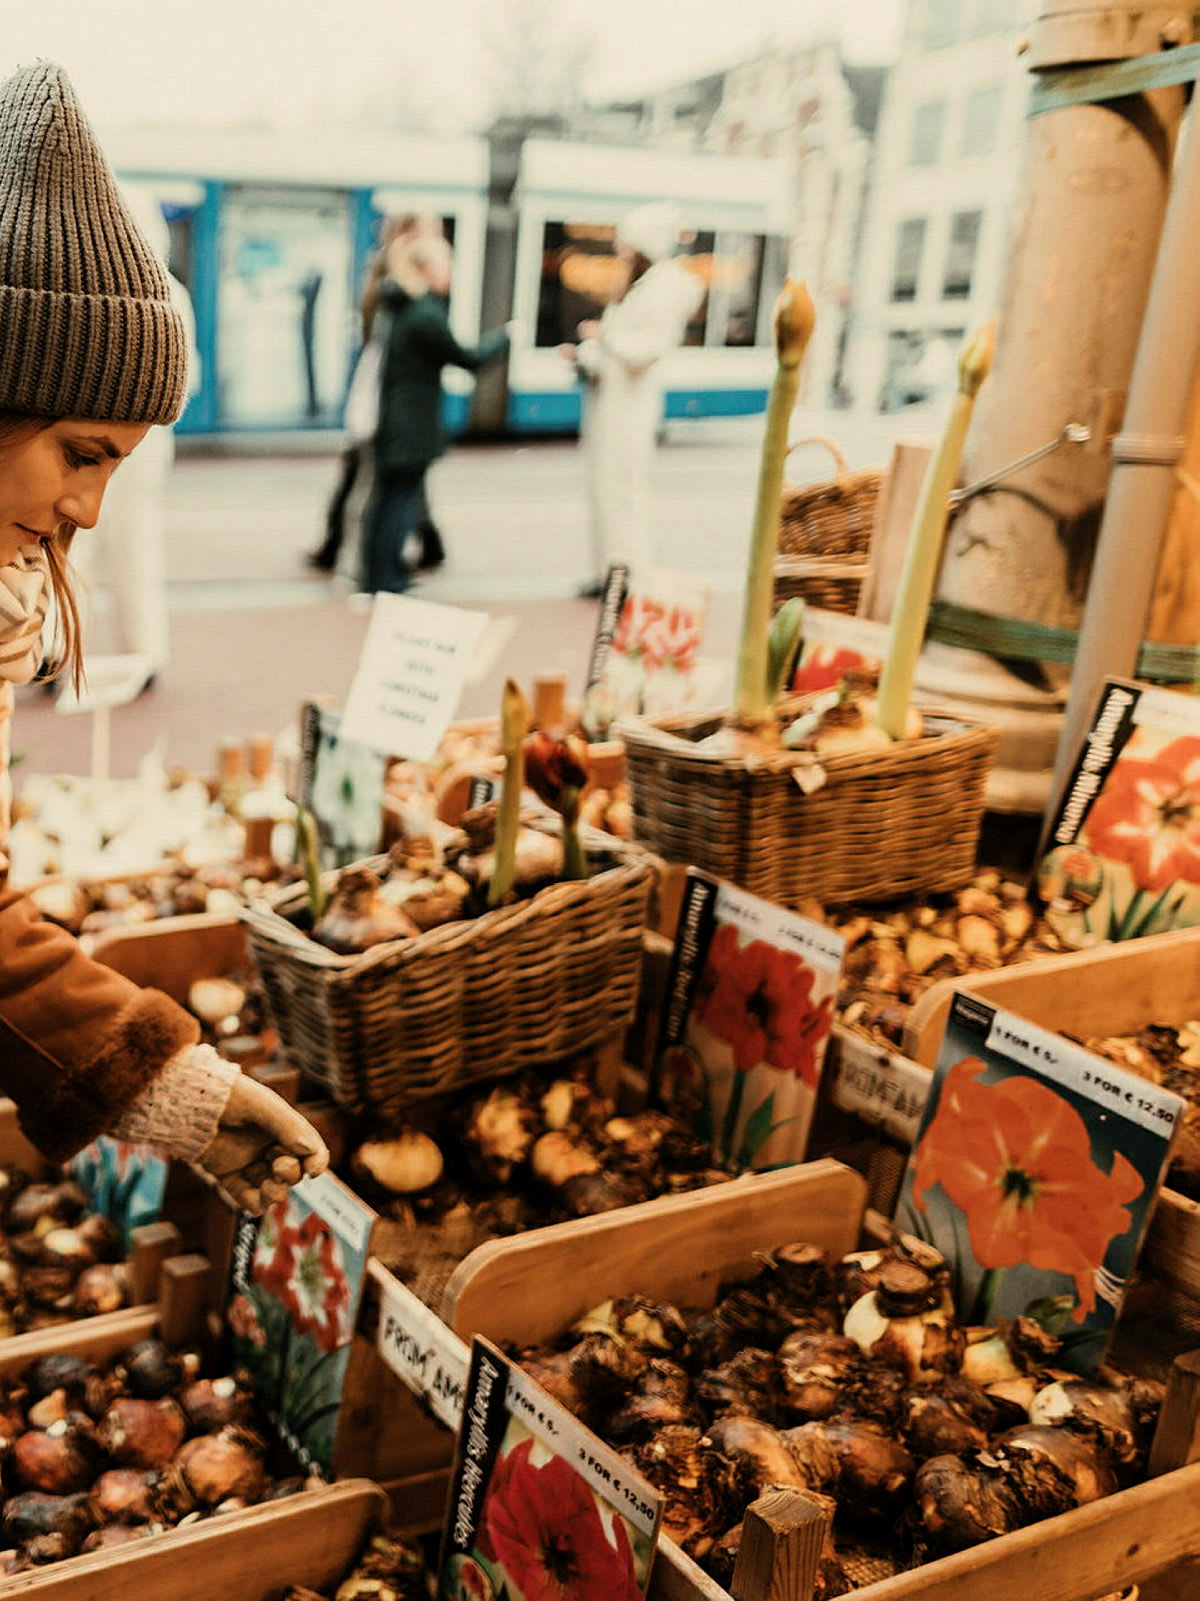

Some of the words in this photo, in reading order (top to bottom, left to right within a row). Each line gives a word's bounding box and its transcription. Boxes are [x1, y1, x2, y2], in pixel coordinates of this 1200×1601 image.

[1004, 1031, 1030, 1050] FOR
[1083, 1070, 1091, 1081] 3
[1094, 1076, 1121, 1097] FOR
[467, 1355, 500, 1461] Amaryllis
[515, 1391, 536, 1417] FOR
[453, 1457, 483, 1550] Hercules
[578, 1448, 586, 1460] 3
[587, 1456, 612, 1483] FOR
[623, 1487, 656, 1521] 12,50
